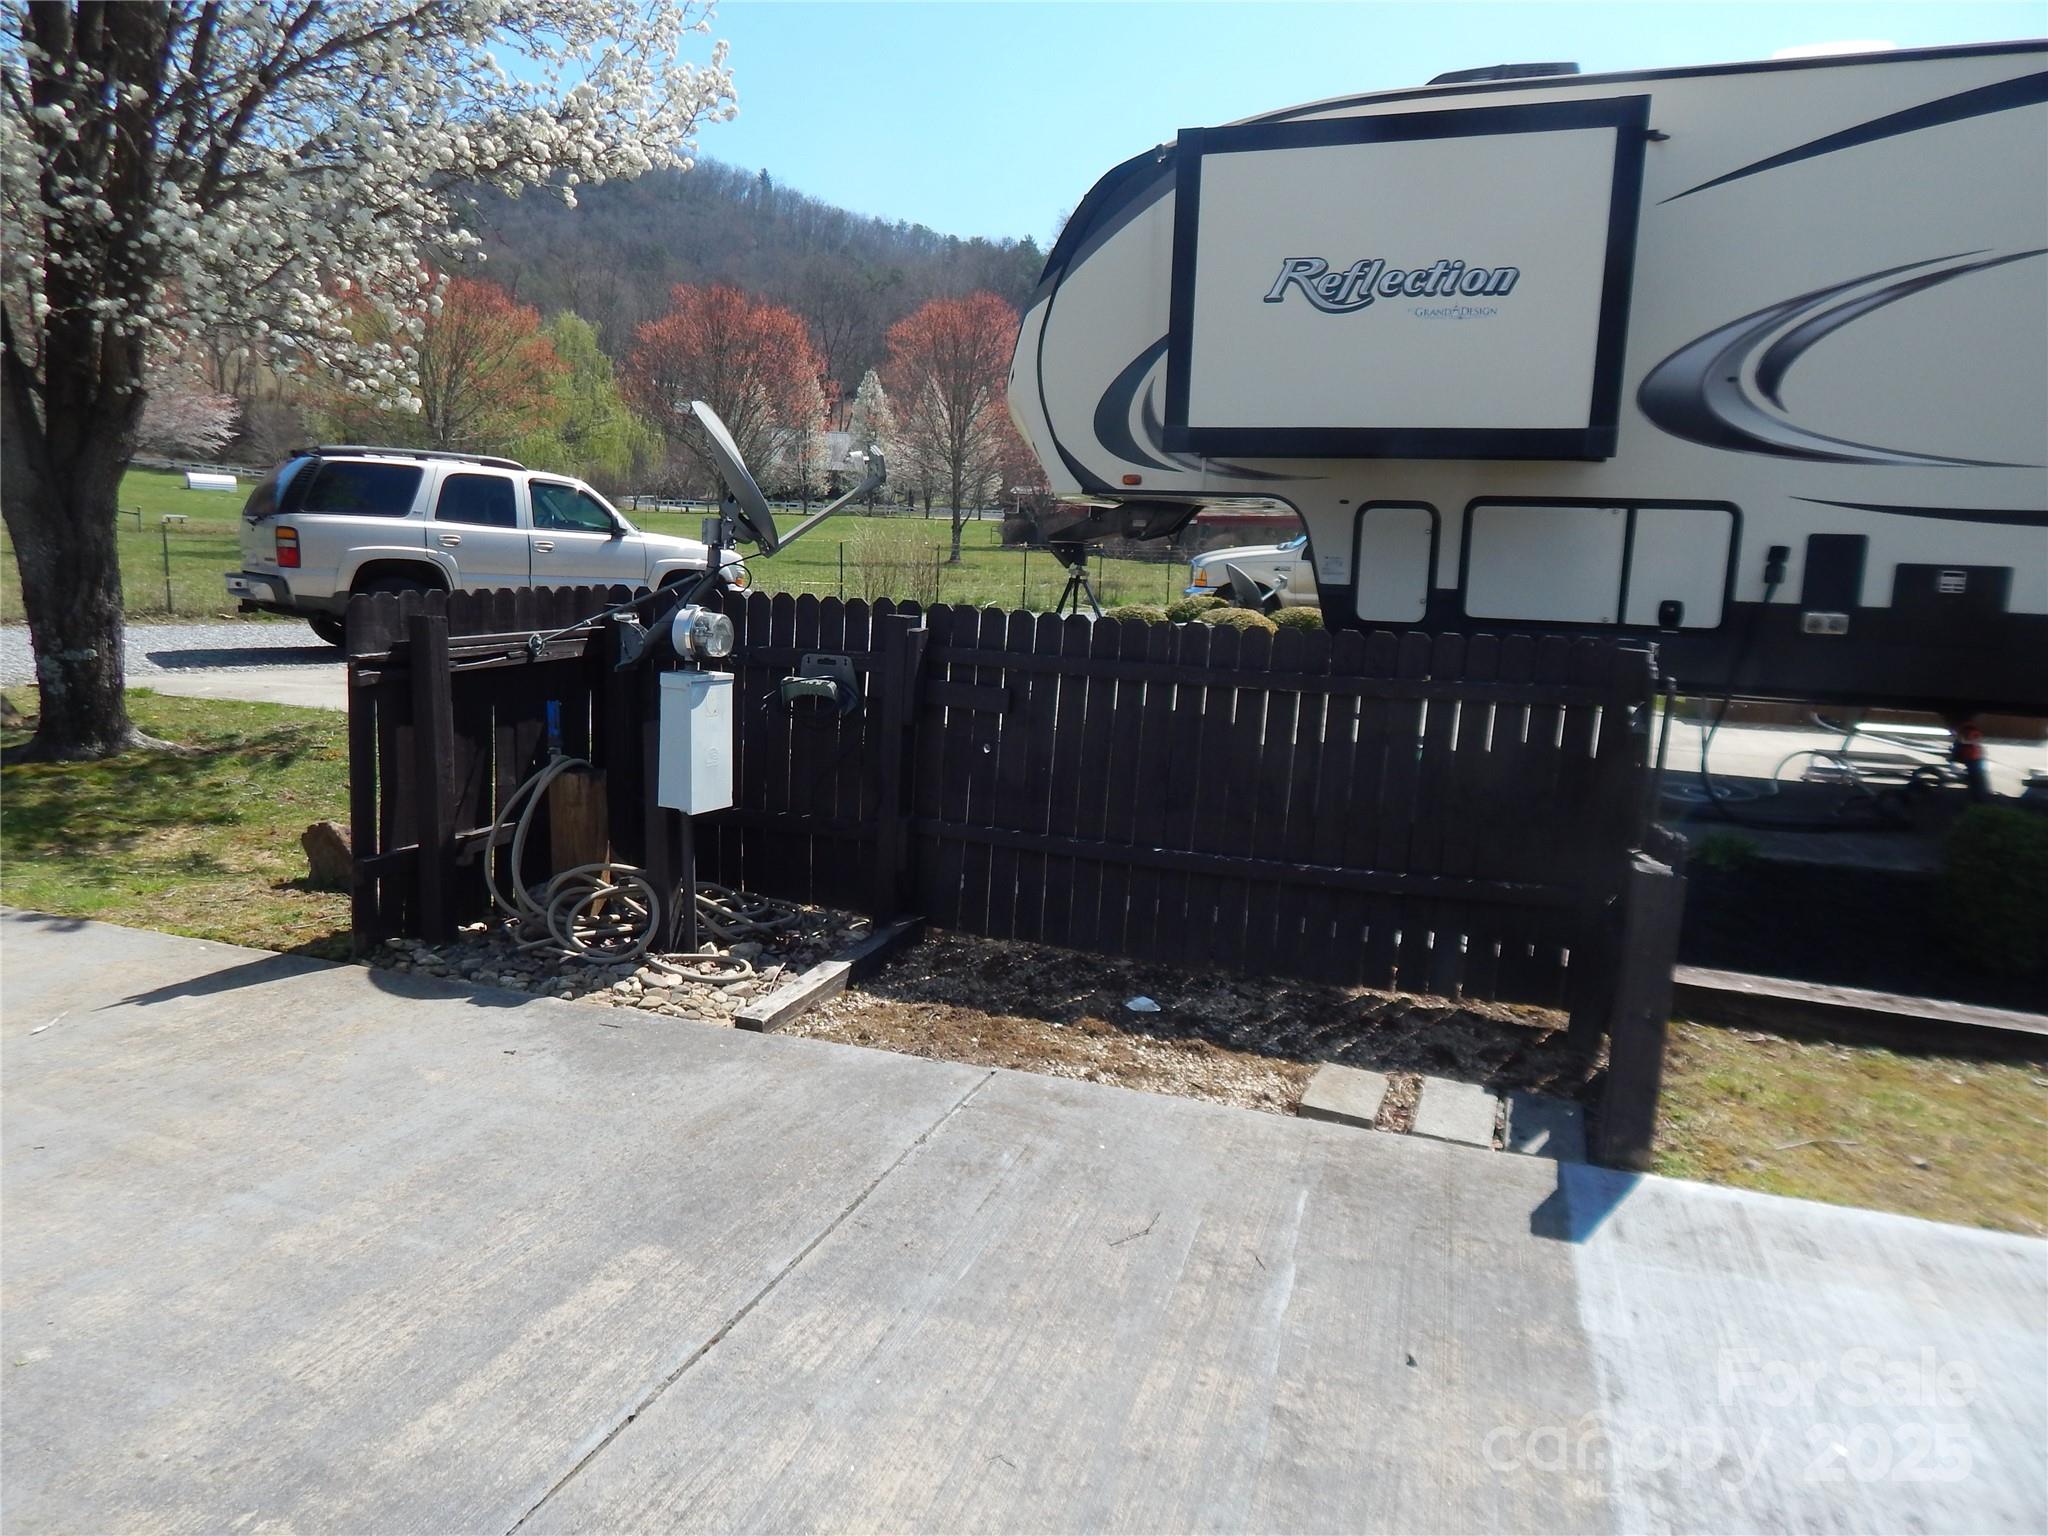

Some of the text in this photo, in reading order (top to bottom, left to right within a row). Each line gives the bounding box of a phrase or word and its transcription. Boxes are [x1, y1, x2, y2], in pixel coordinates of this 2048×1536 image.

[1263, 257, 1520, 314] Reflection
[1415, 307, 1452, 317] GRAND
[1460, 306, 1498, 317] DESIGN
